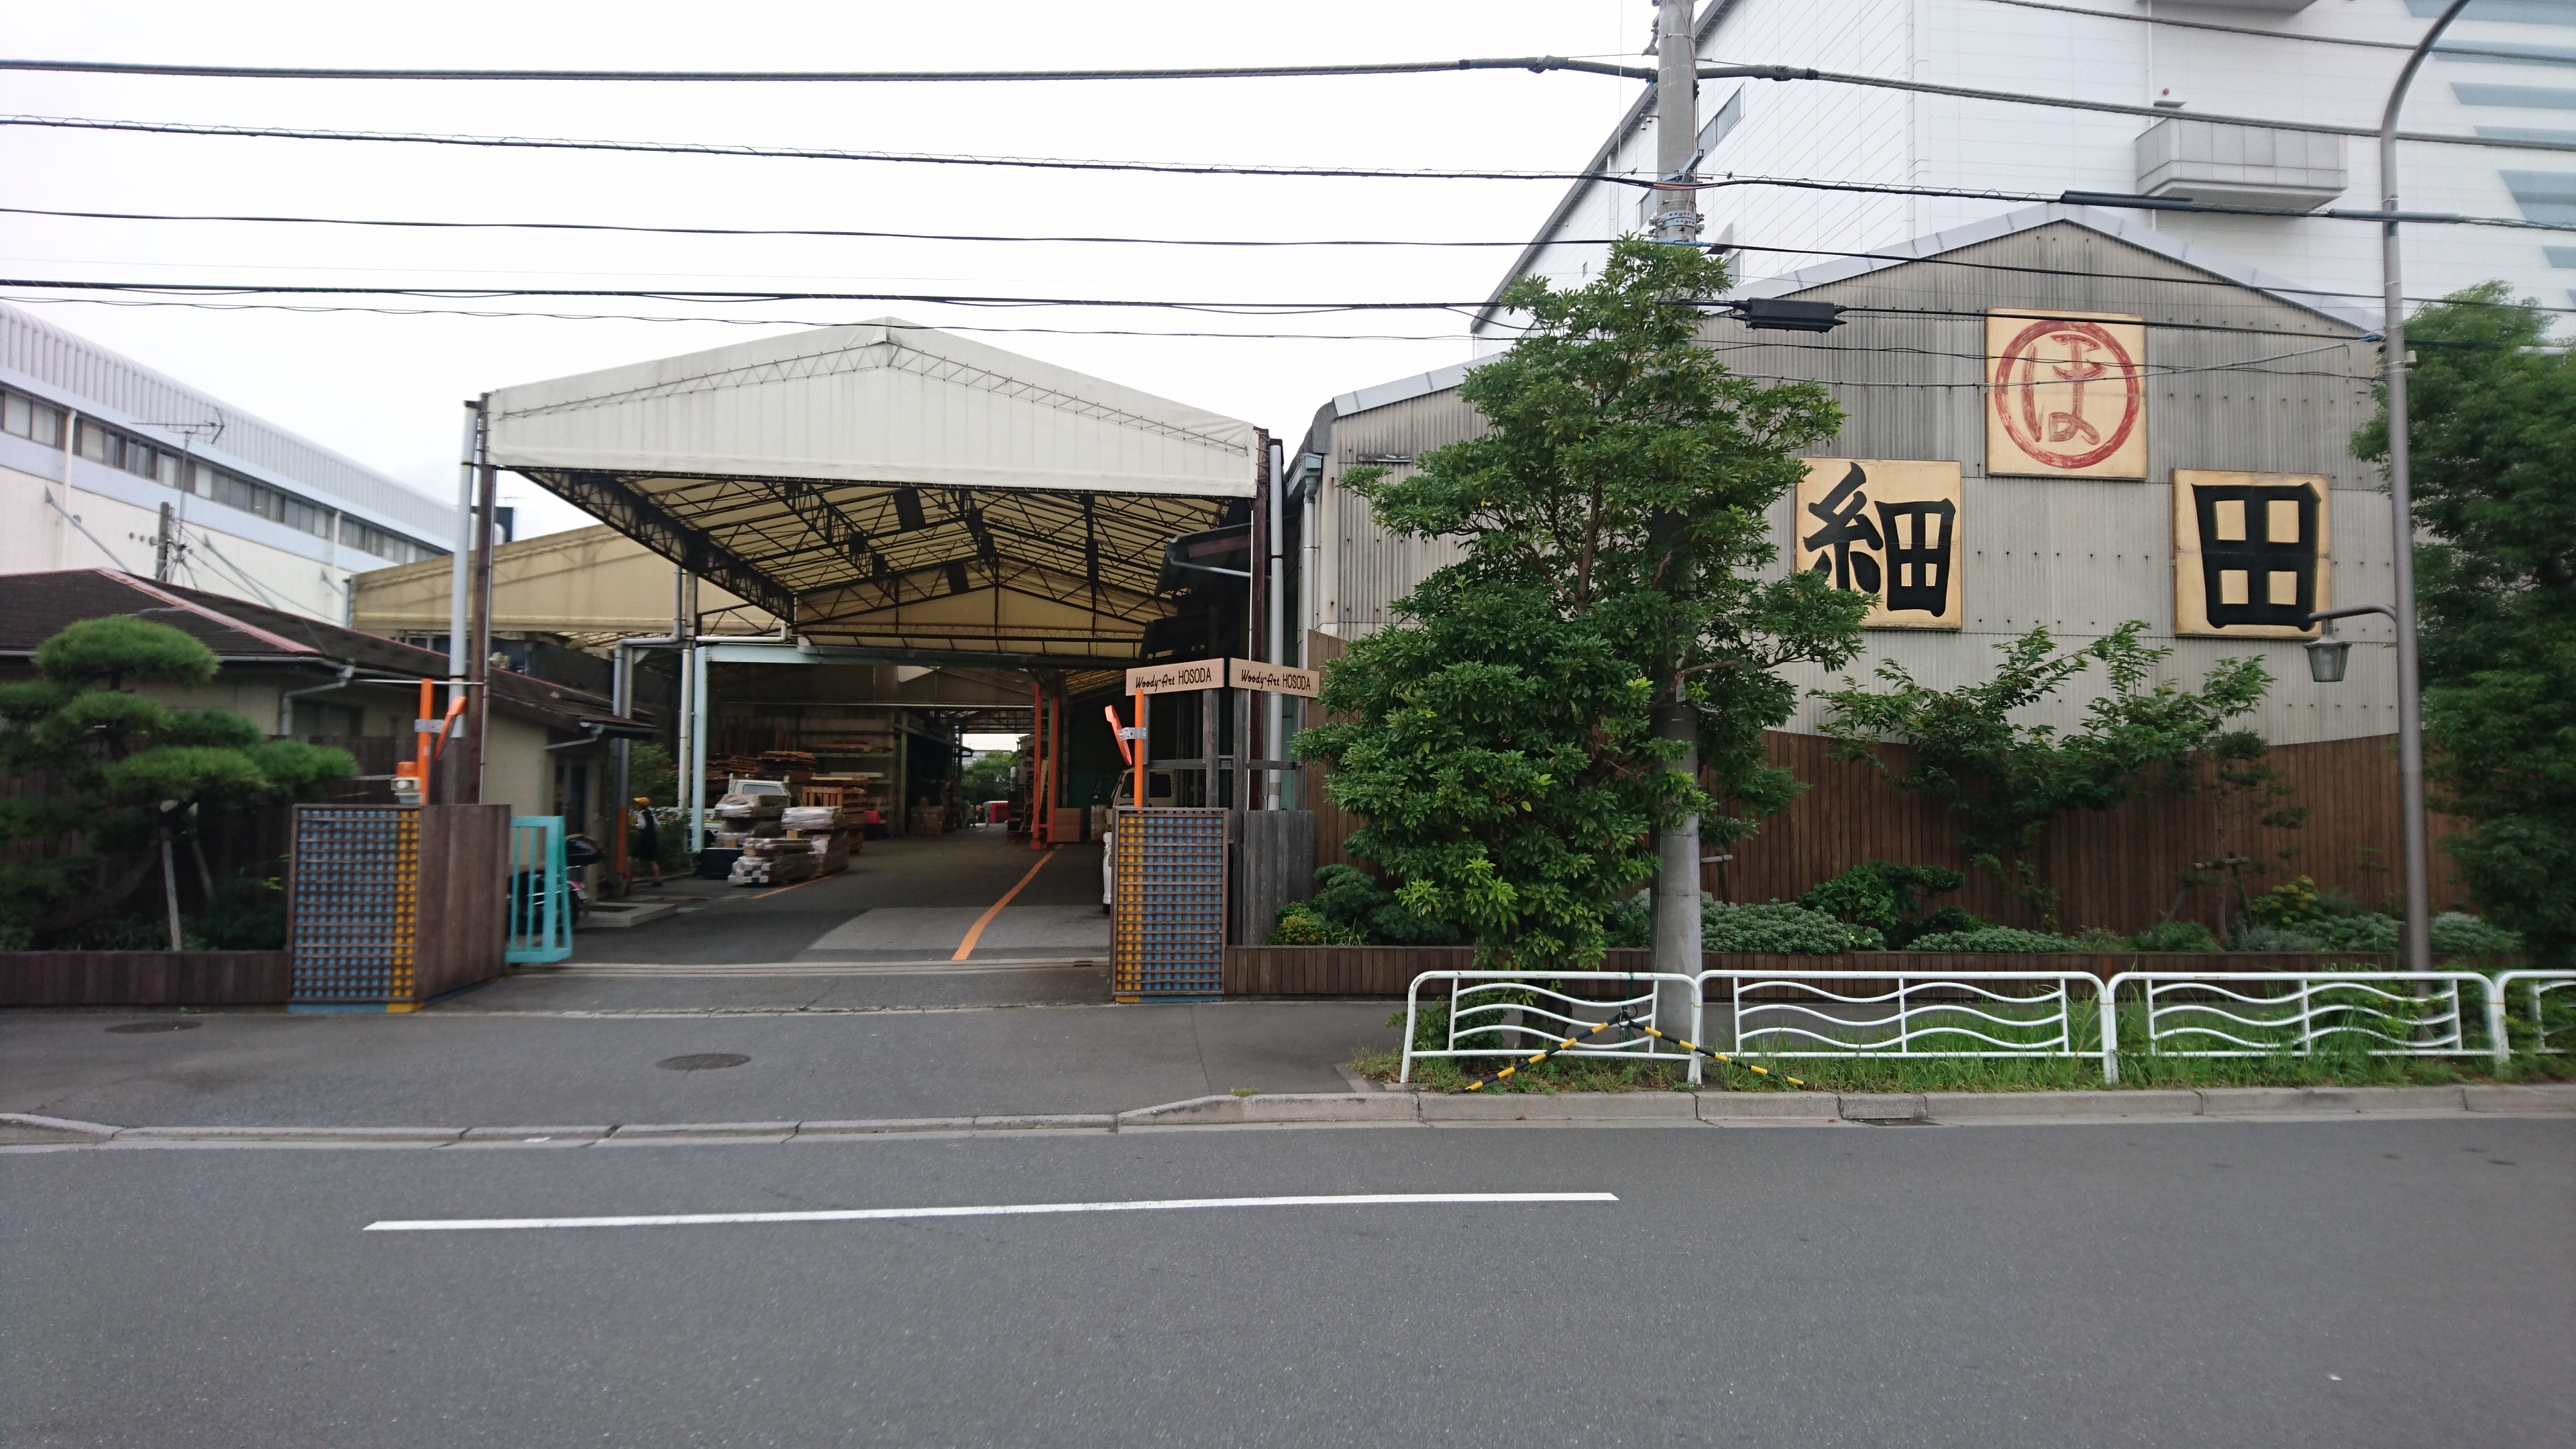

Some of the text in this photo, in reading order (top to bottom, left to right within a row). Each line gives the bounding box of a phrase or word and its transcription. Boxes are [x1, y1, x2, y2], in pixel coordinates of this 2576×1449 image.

[1803, 462, 2322, 631] 細 田
[1135, 667, 1212, 692] Woody-Art HOSODA
[1241, 669, 1311, 692] Woody-Art HOSODA
